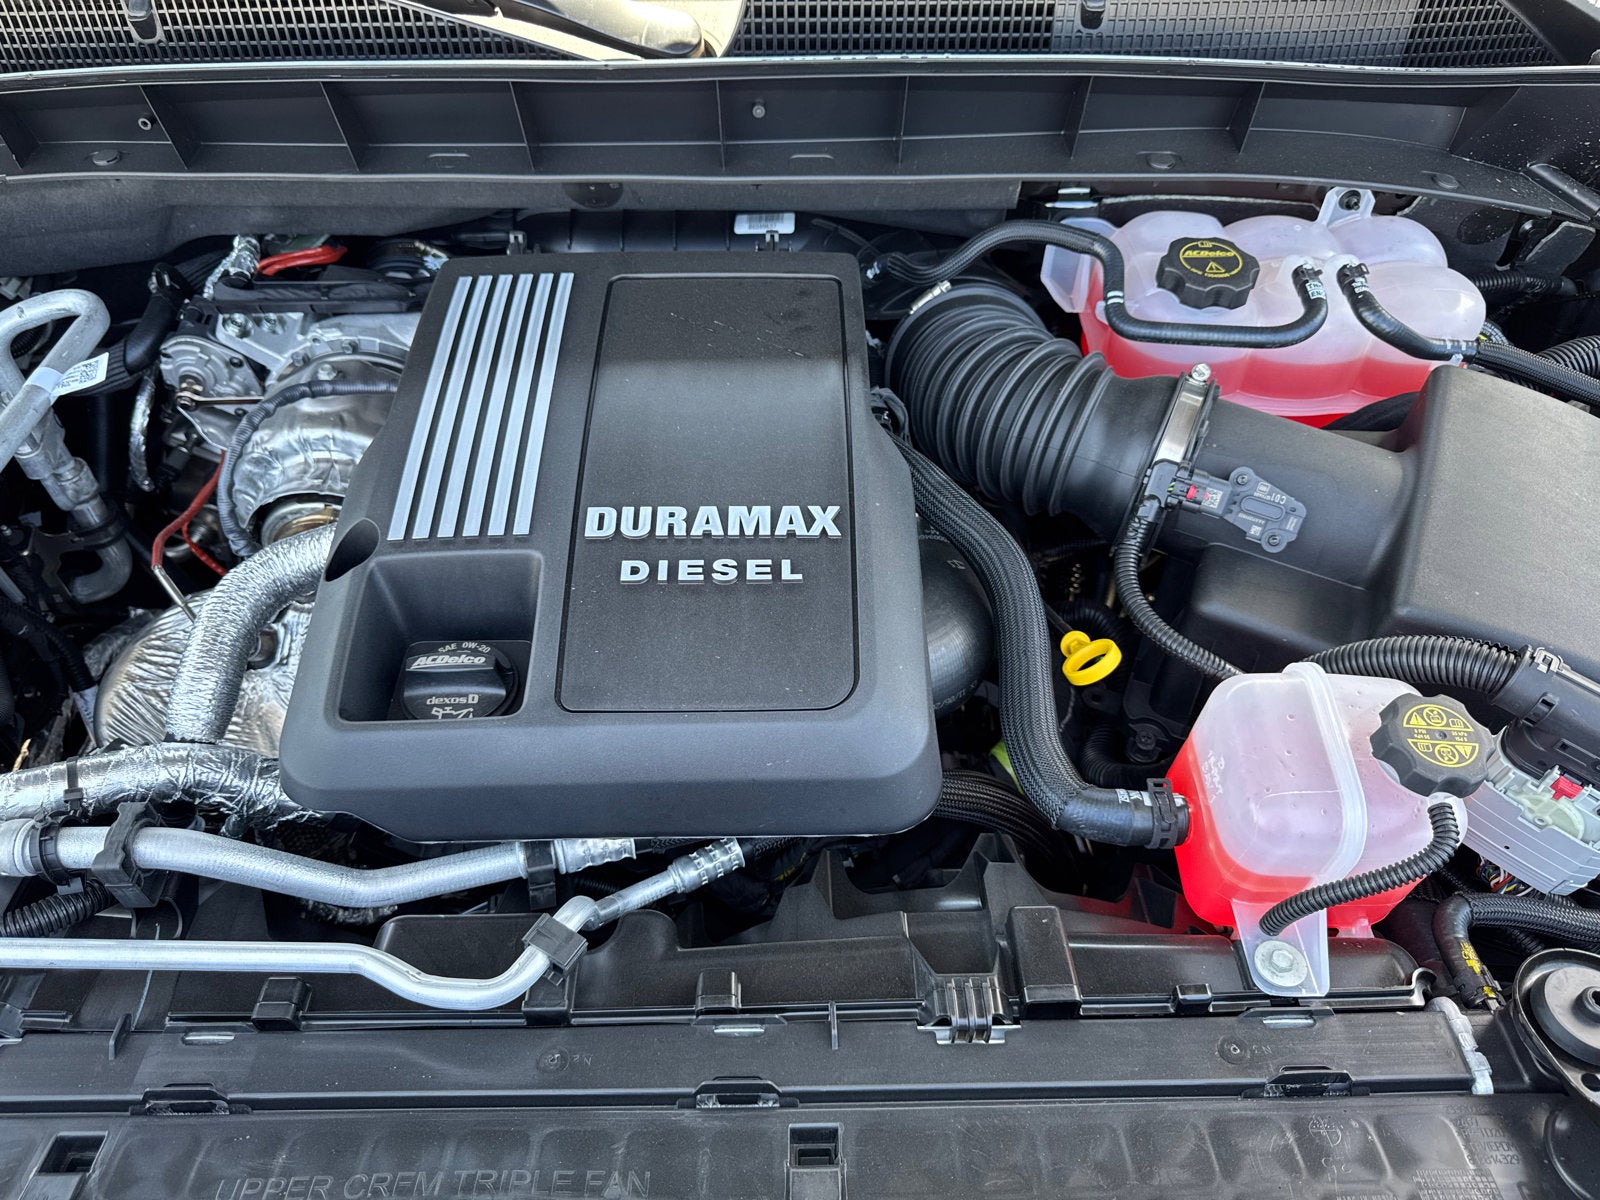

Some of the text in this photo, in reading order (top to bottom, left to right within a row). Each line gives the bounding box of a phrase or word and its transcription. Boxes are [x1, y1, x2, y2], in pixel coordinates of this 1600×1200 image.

[1182, 249, 1235, 257] ACDelco
[584, 505, 842, 539] DURAMAX
[620, 559, 803, 584] DIESEL
[438, 642, 491, 653] SAE 0W-20
[411, 654, 486, 668] ACDelco
[214, 1175, 335, 1200] UPPER
[454, 1168, 577, 1200] TRIPLE
[584, 1169, 651, 1199] FAN
